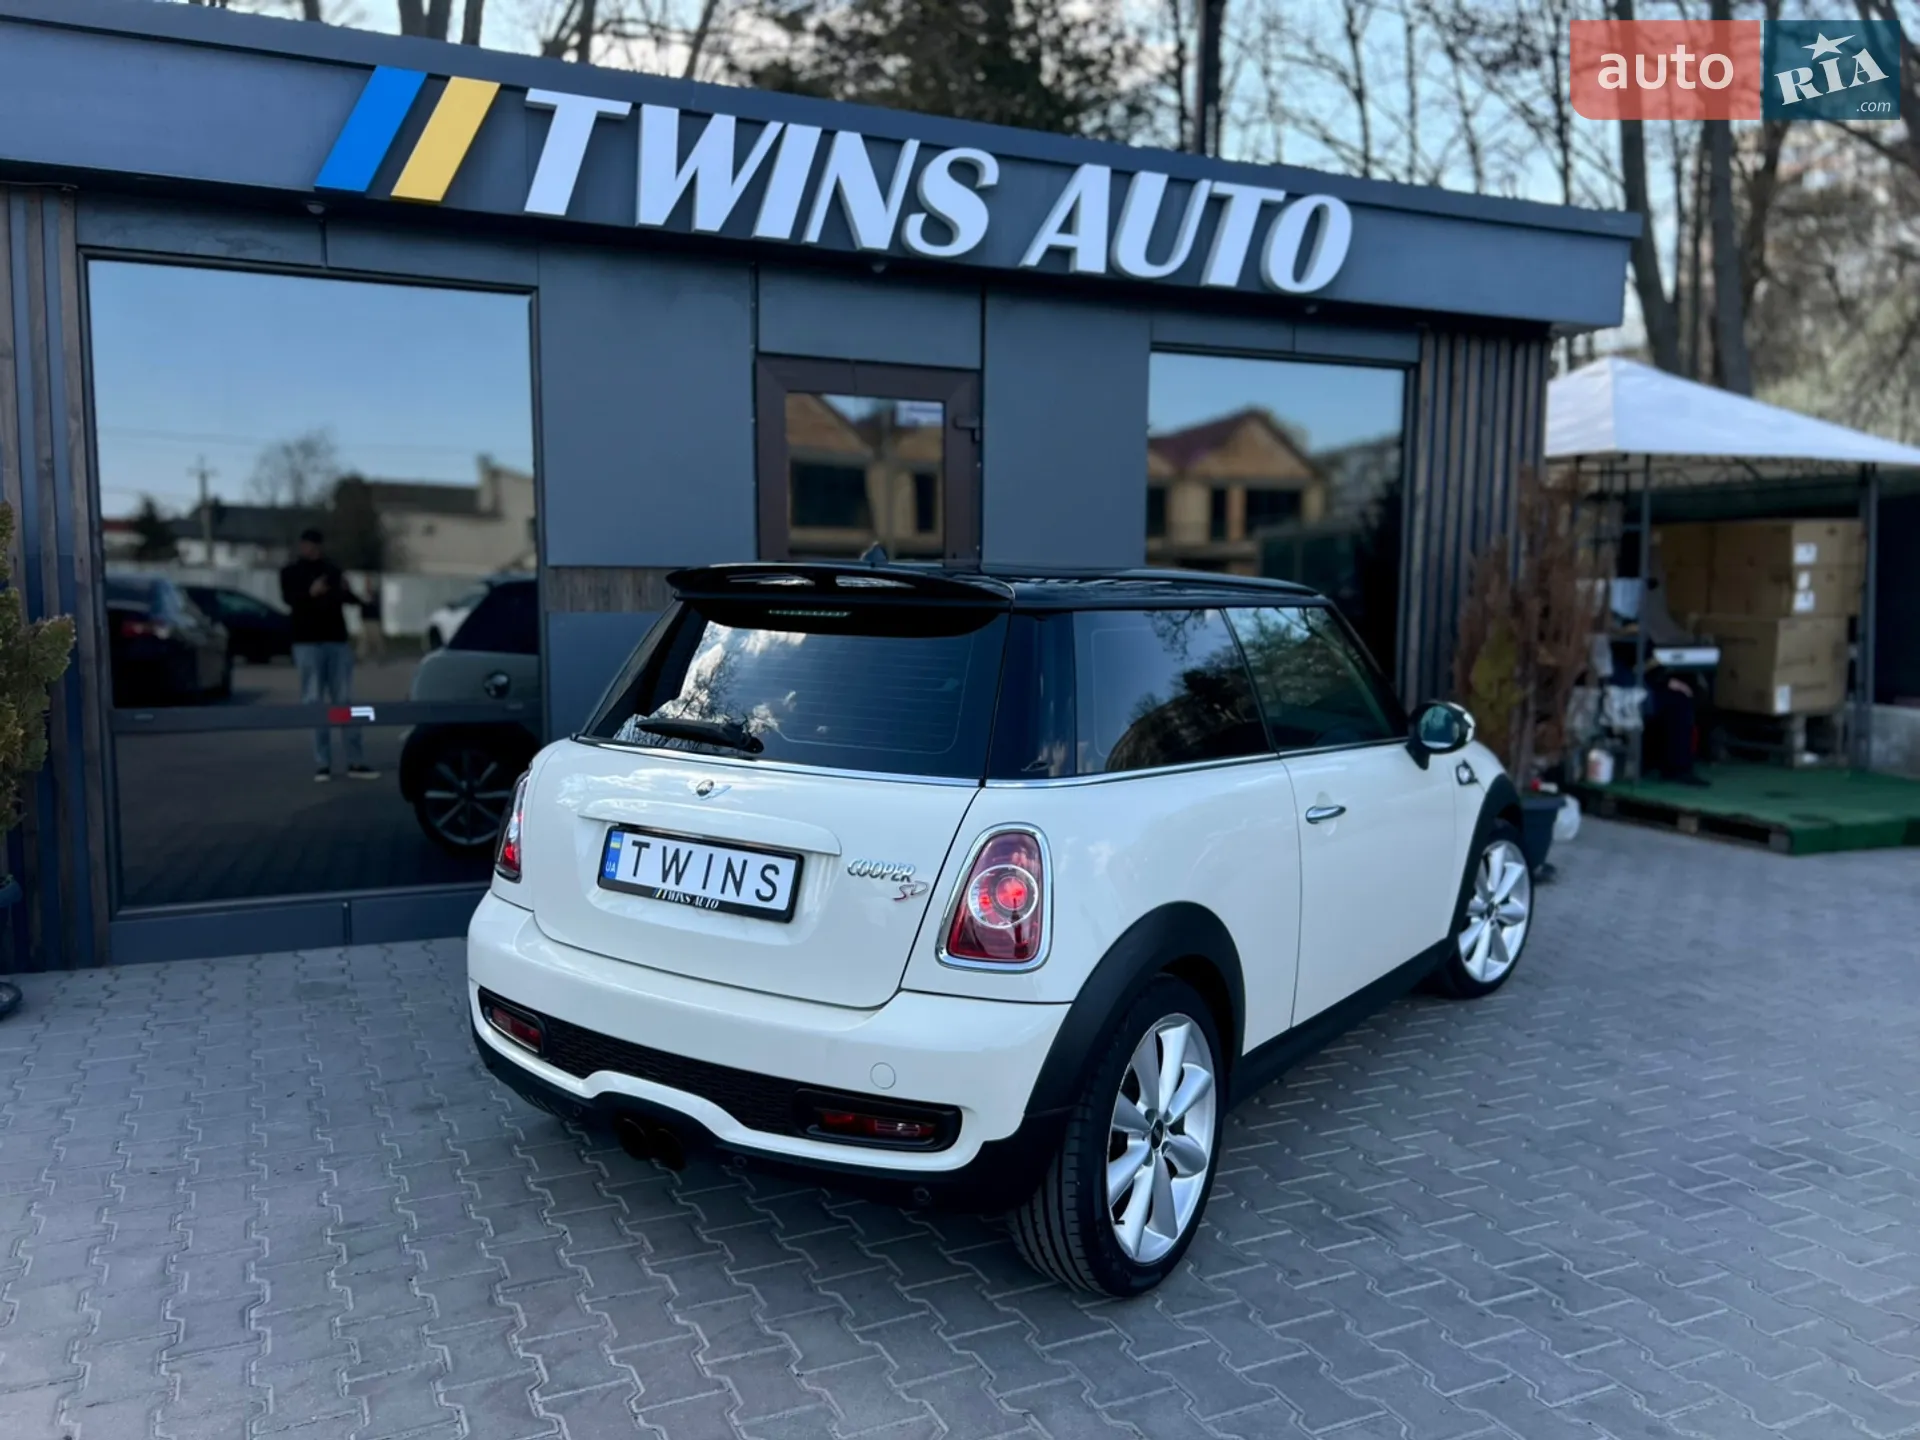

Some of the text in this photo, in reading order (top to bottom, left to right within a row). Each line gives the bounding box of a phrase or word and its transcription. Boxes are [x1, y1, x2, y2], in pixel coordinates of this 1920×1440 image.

[523, 88, 1353, 295] TWINS AUTO
[605, 860, 617, 873] UA
[847, 858, 917, 883] COOPER
